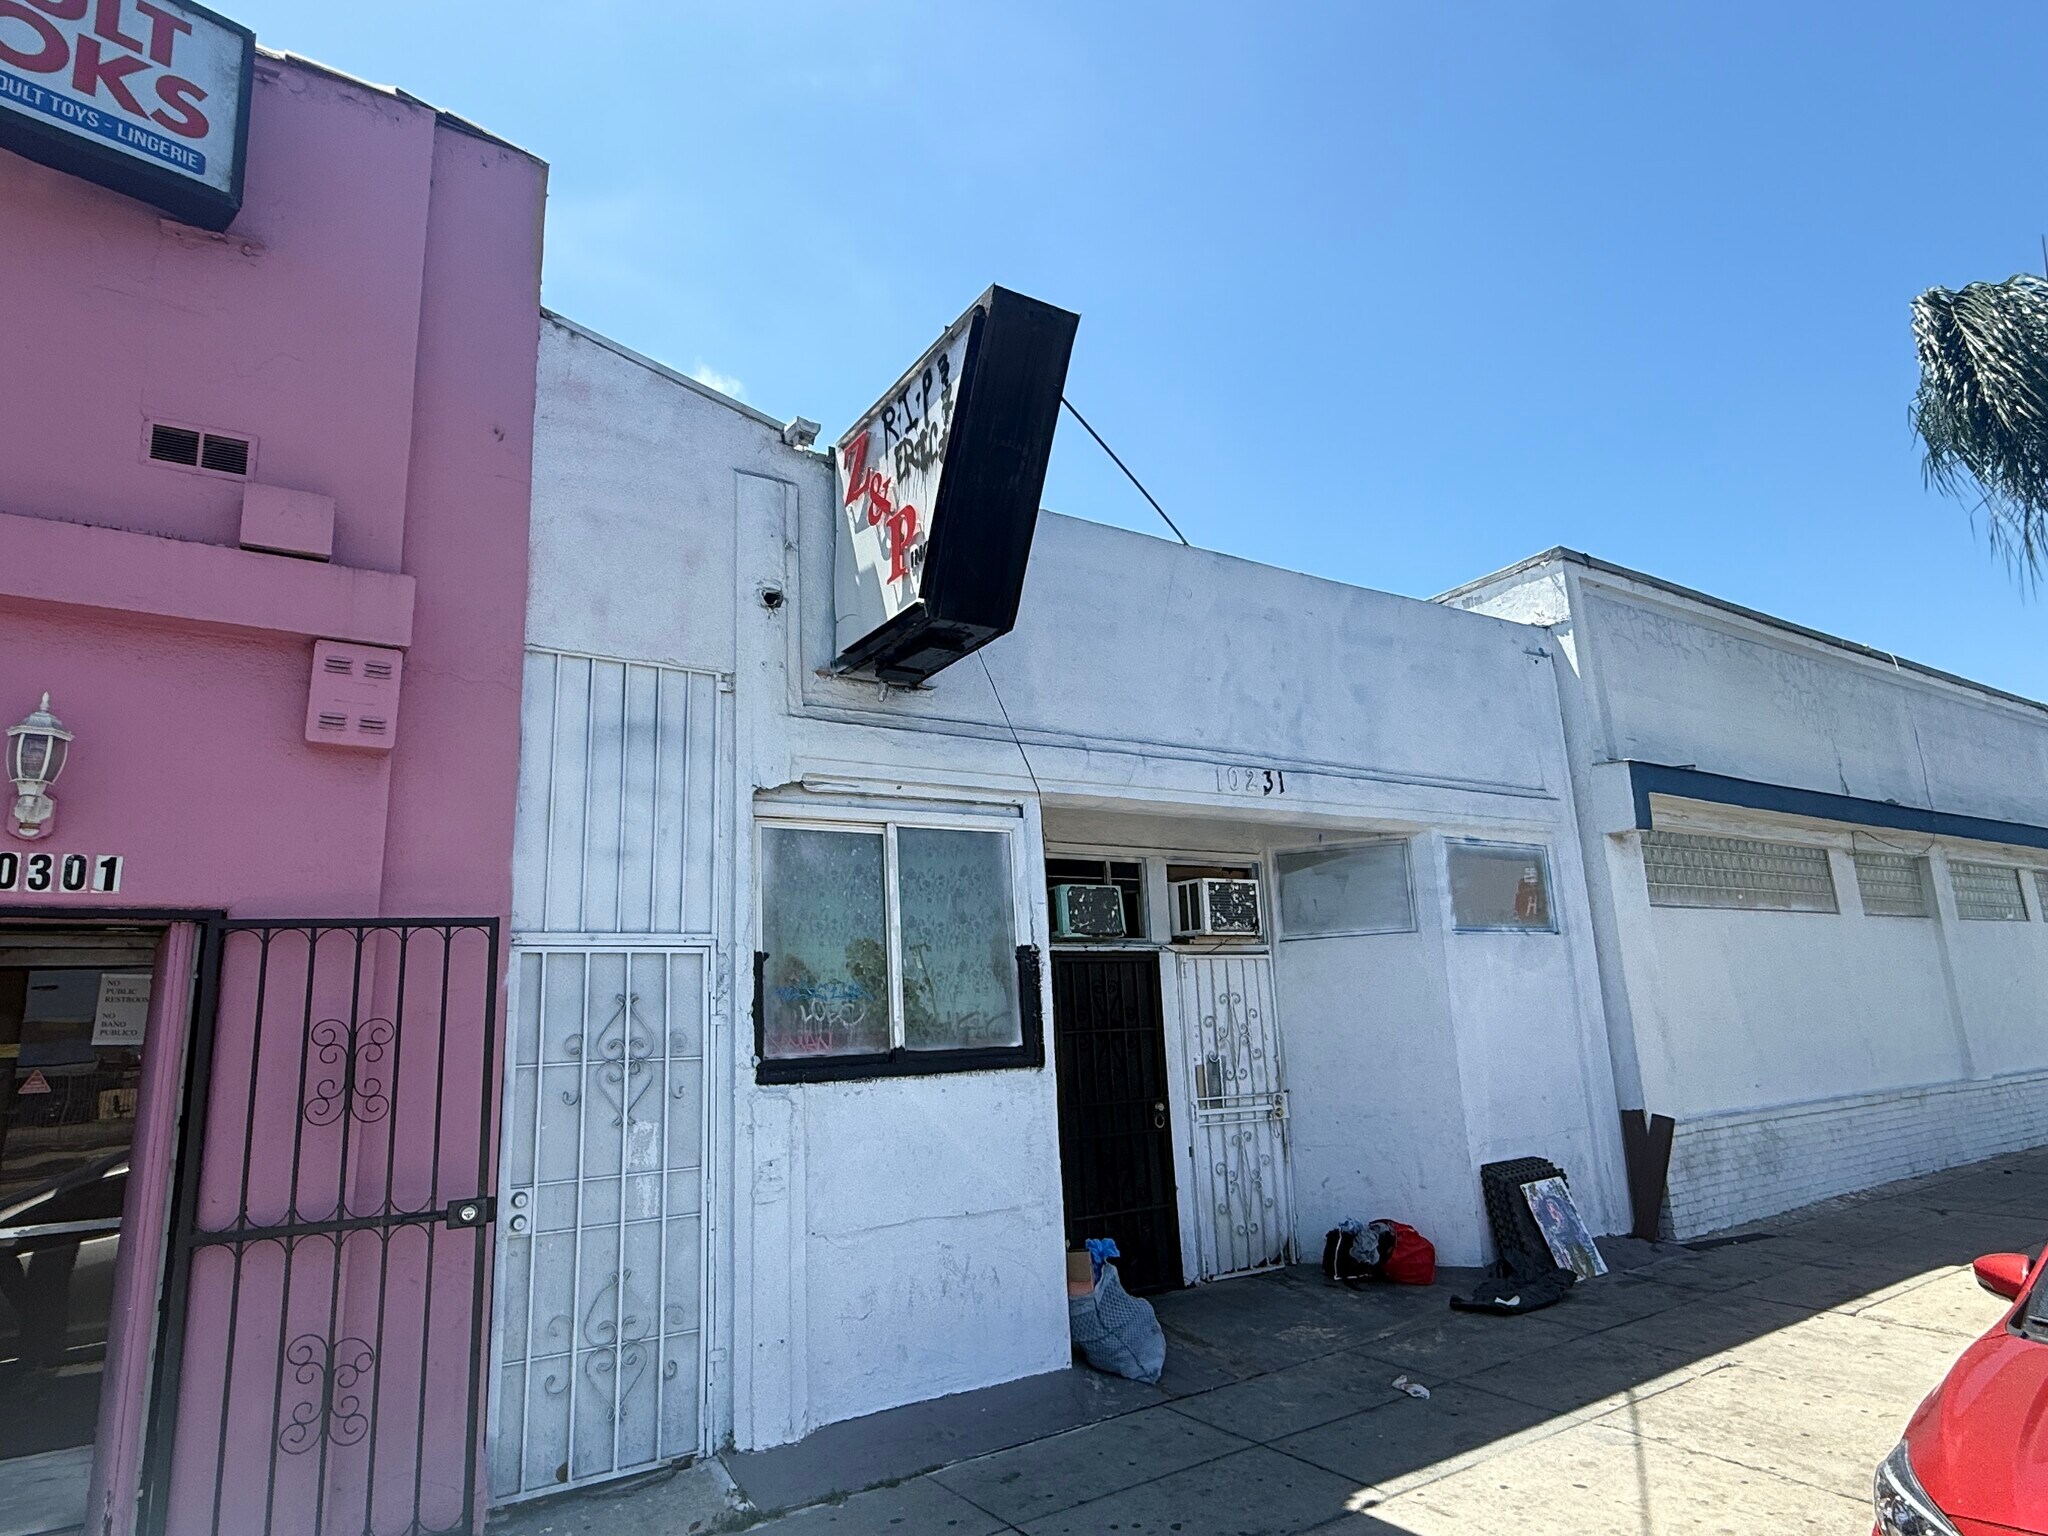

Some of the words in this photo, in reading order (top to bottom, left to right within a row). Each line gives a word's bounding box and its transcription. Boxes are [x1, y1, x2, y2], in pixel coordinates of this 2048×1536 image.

[49, 94, 99, 128] TOYS
[117, 122, 200, 169] LINGERIE
[1215, 765, 1286, 796] 10231
[107, 979, 121, 987] NO
